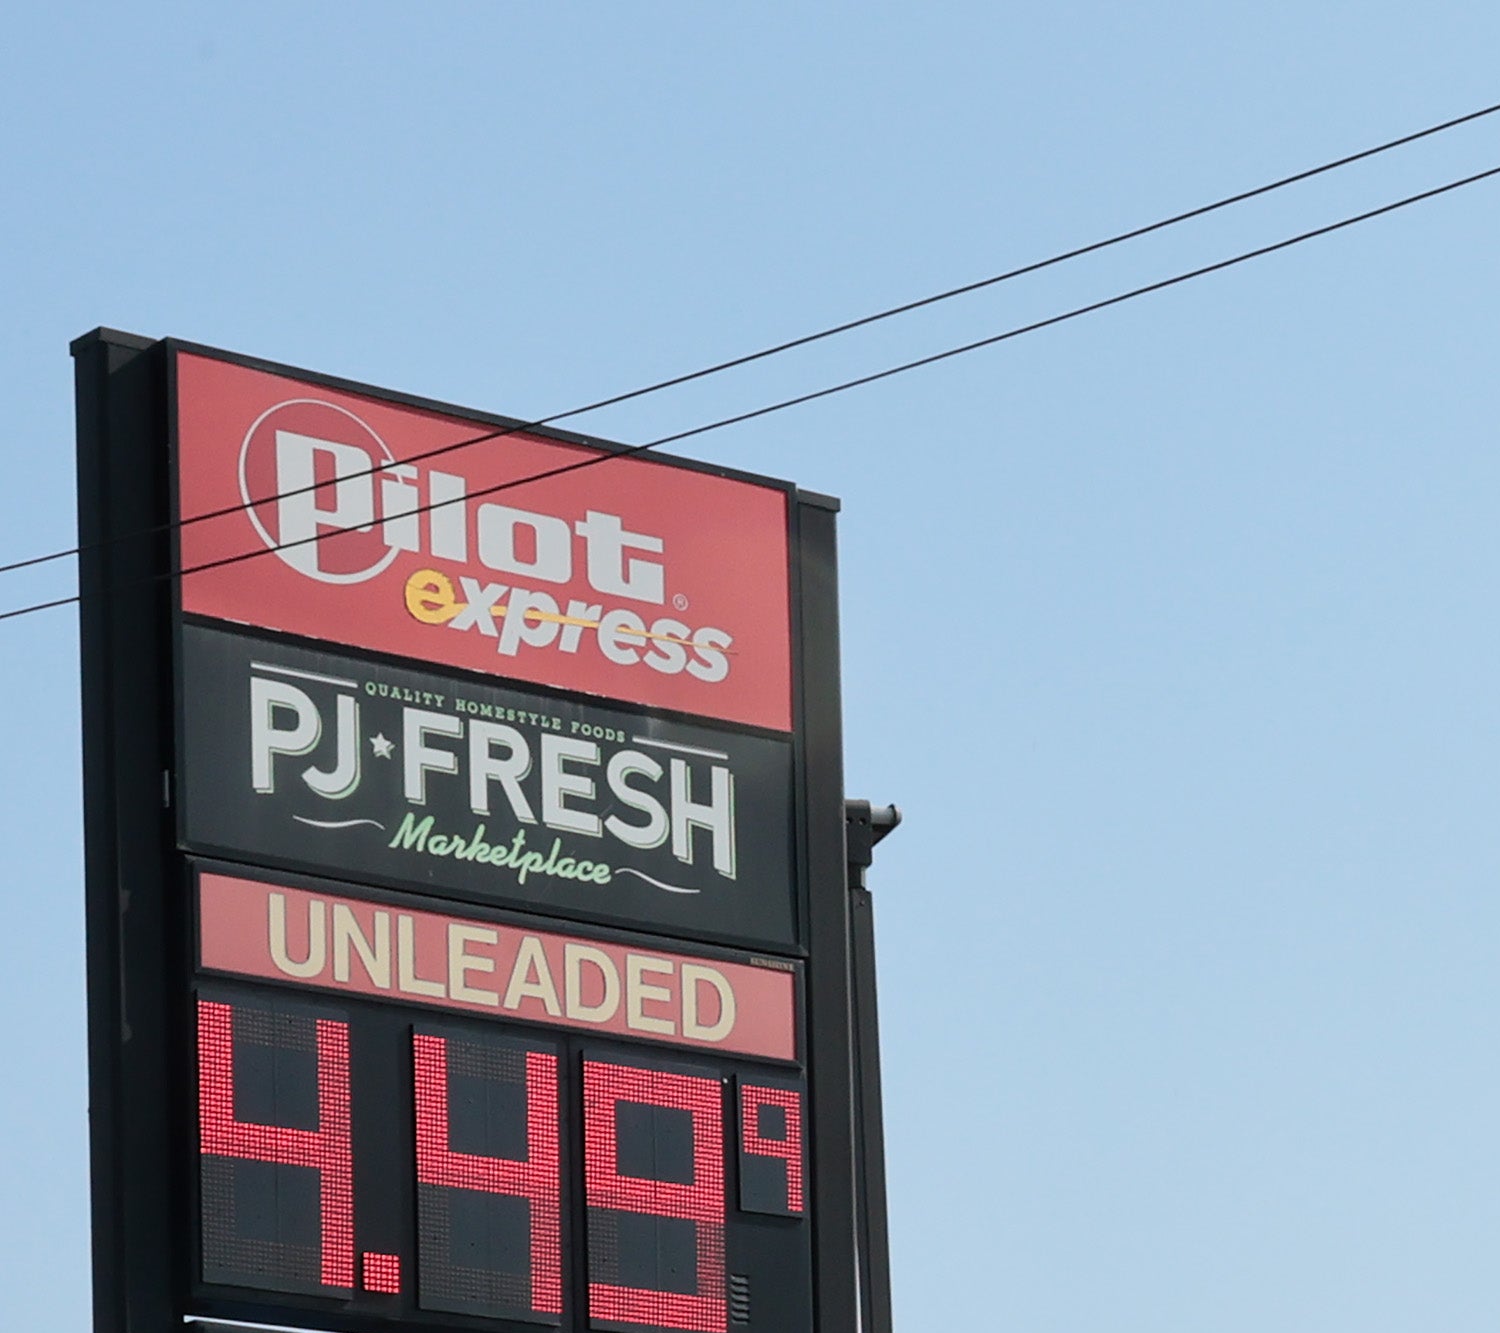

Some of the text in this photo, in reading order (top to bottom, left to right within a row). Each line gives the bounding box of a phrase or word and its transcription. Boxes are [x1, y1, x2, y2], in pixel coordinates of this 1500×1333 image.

[274, 429, 664, 604] Pilot
[404, 568, 734, 684] express
[250, 676, 736, 880] PJ FRESH
[365, 681, 626, 743] QUALITY HOMESTYLE FOODS
[390, 813, 612, 885] Marketplace
[267, 892, 736, 1043] UNLEADED
